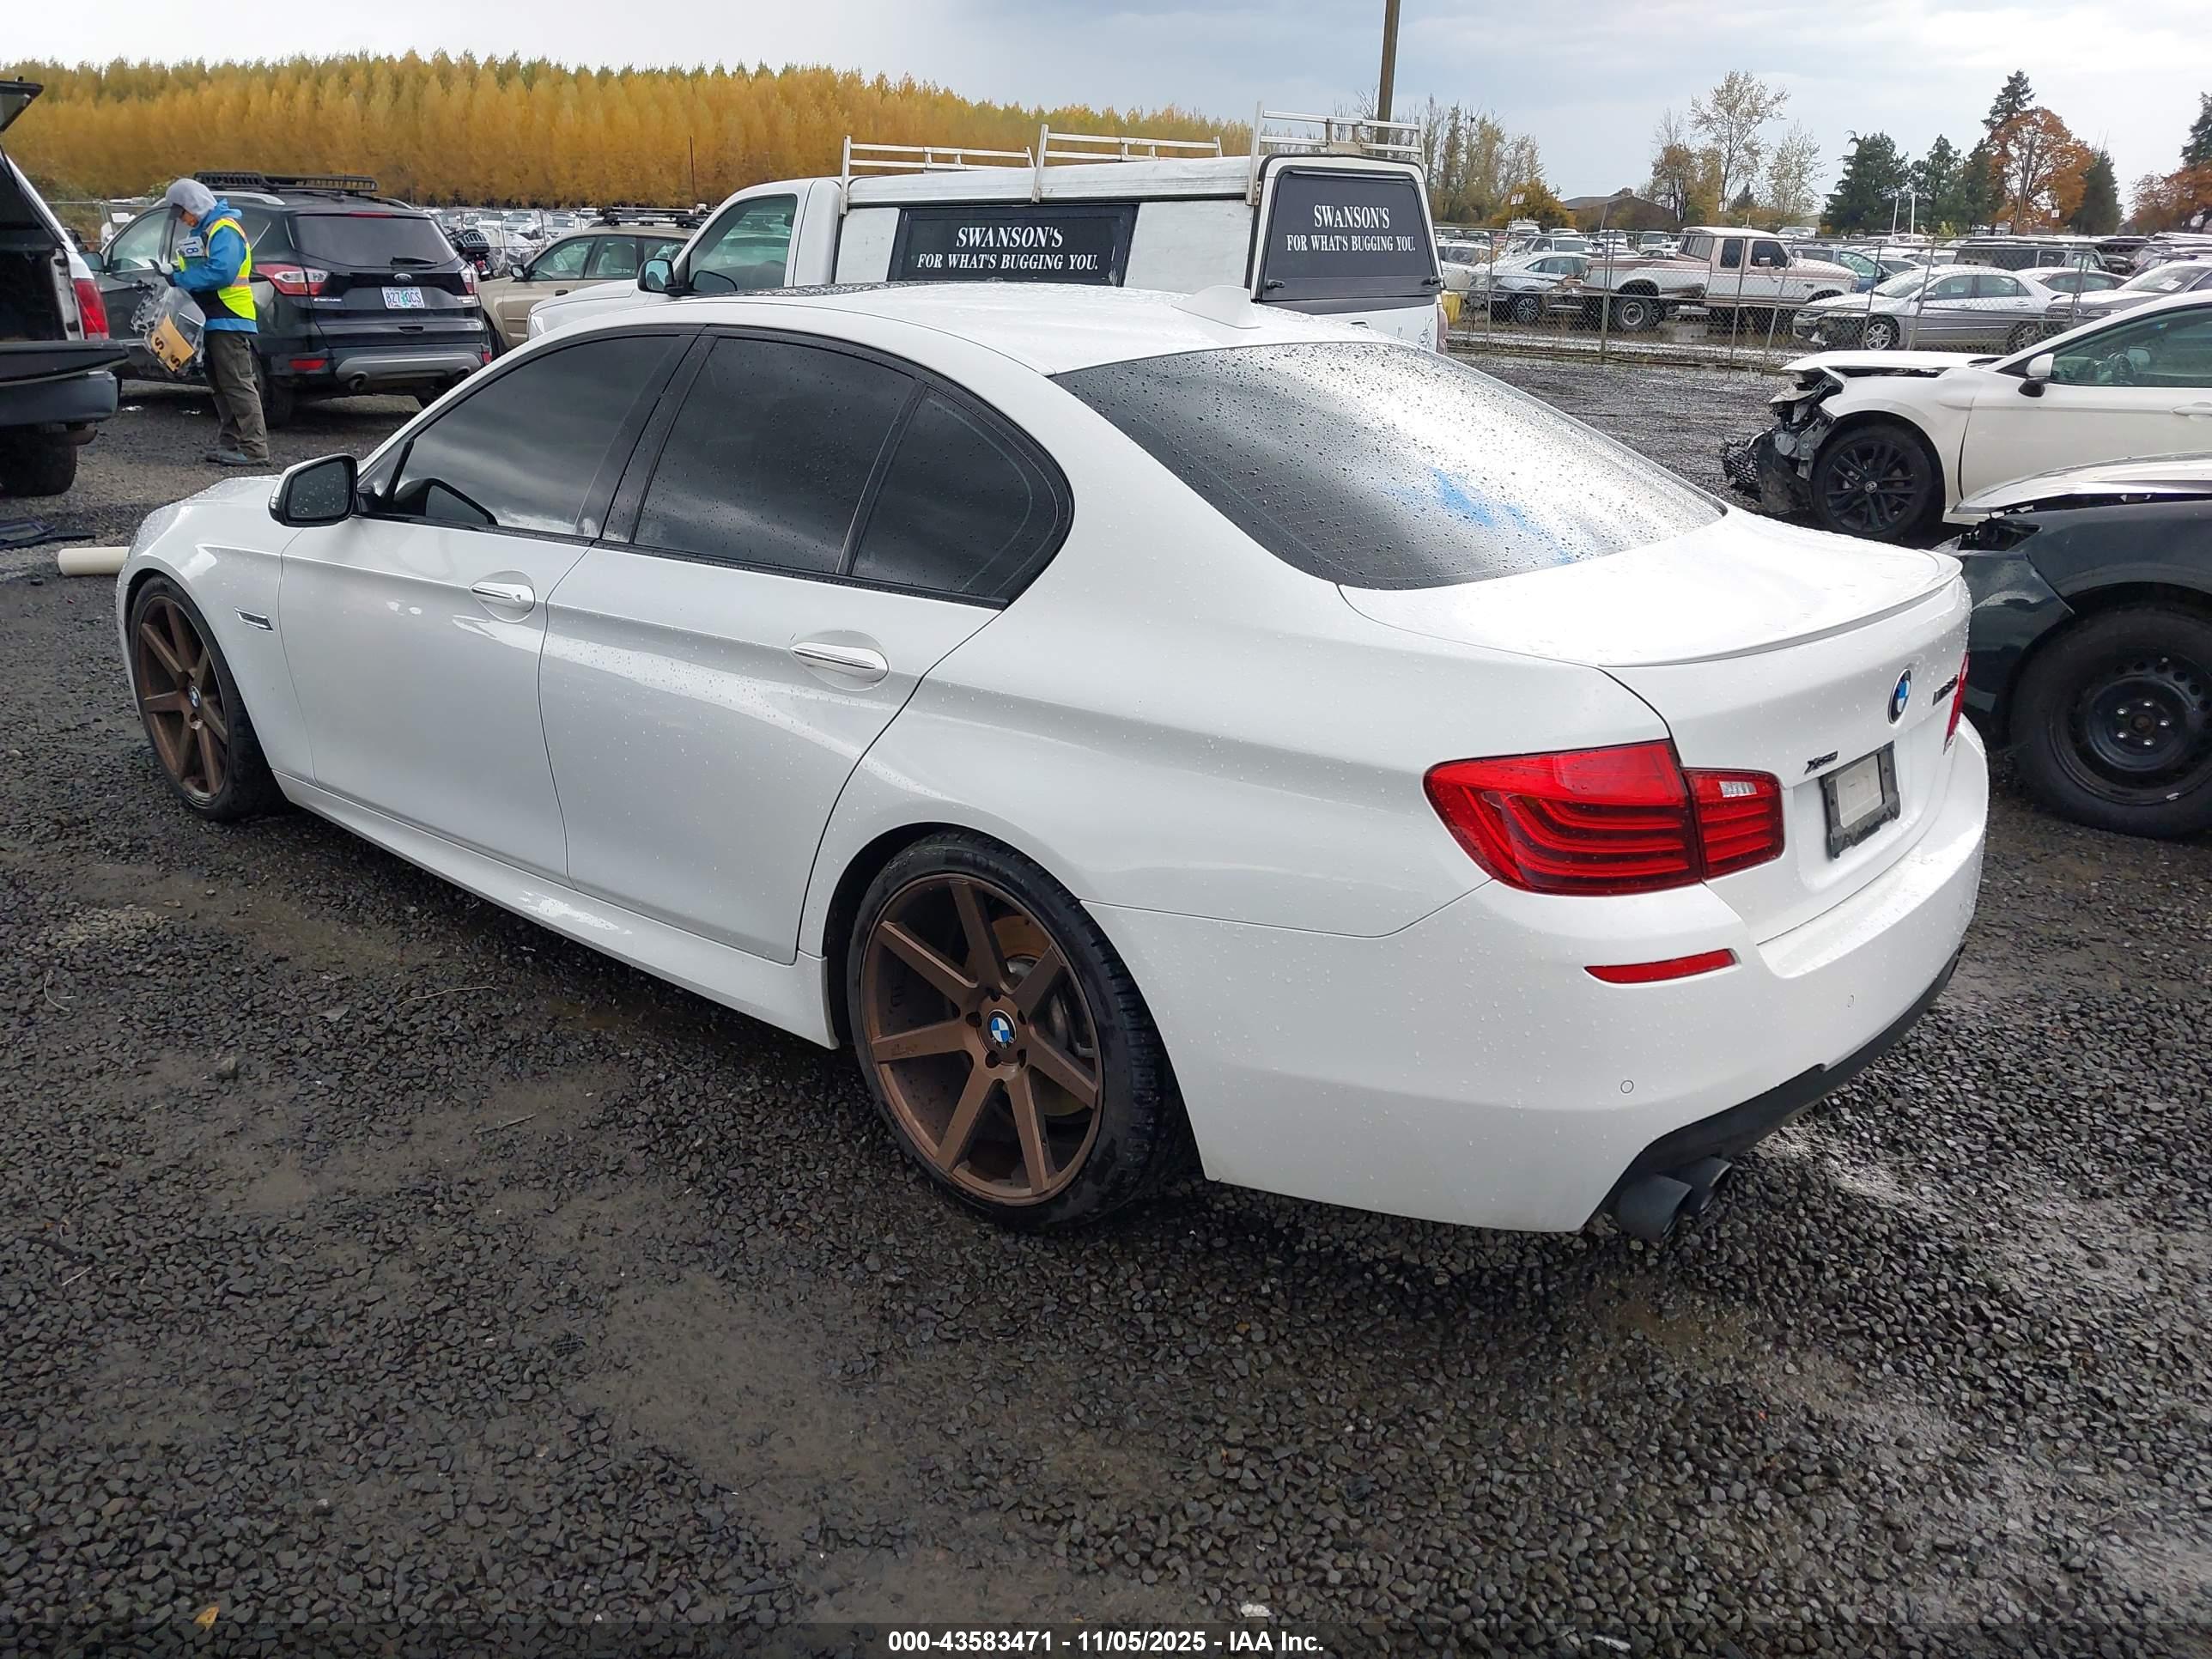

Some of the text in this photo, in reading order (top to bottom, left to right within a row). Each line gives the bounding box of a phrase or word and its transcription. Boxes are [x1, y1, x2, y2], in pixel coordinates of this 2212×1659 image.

[1314, 204, 1390, 229] SWANSON'S
[956, 226, 1063, 248] SWANSON'S
[1286, 234, 1416, 252] FOR WHAT'S BUGGING YOU.
[916, 253, 1098, 270] FOR WHAT'S BUGGING YOU.
[386, 291, 400, 303] 827
